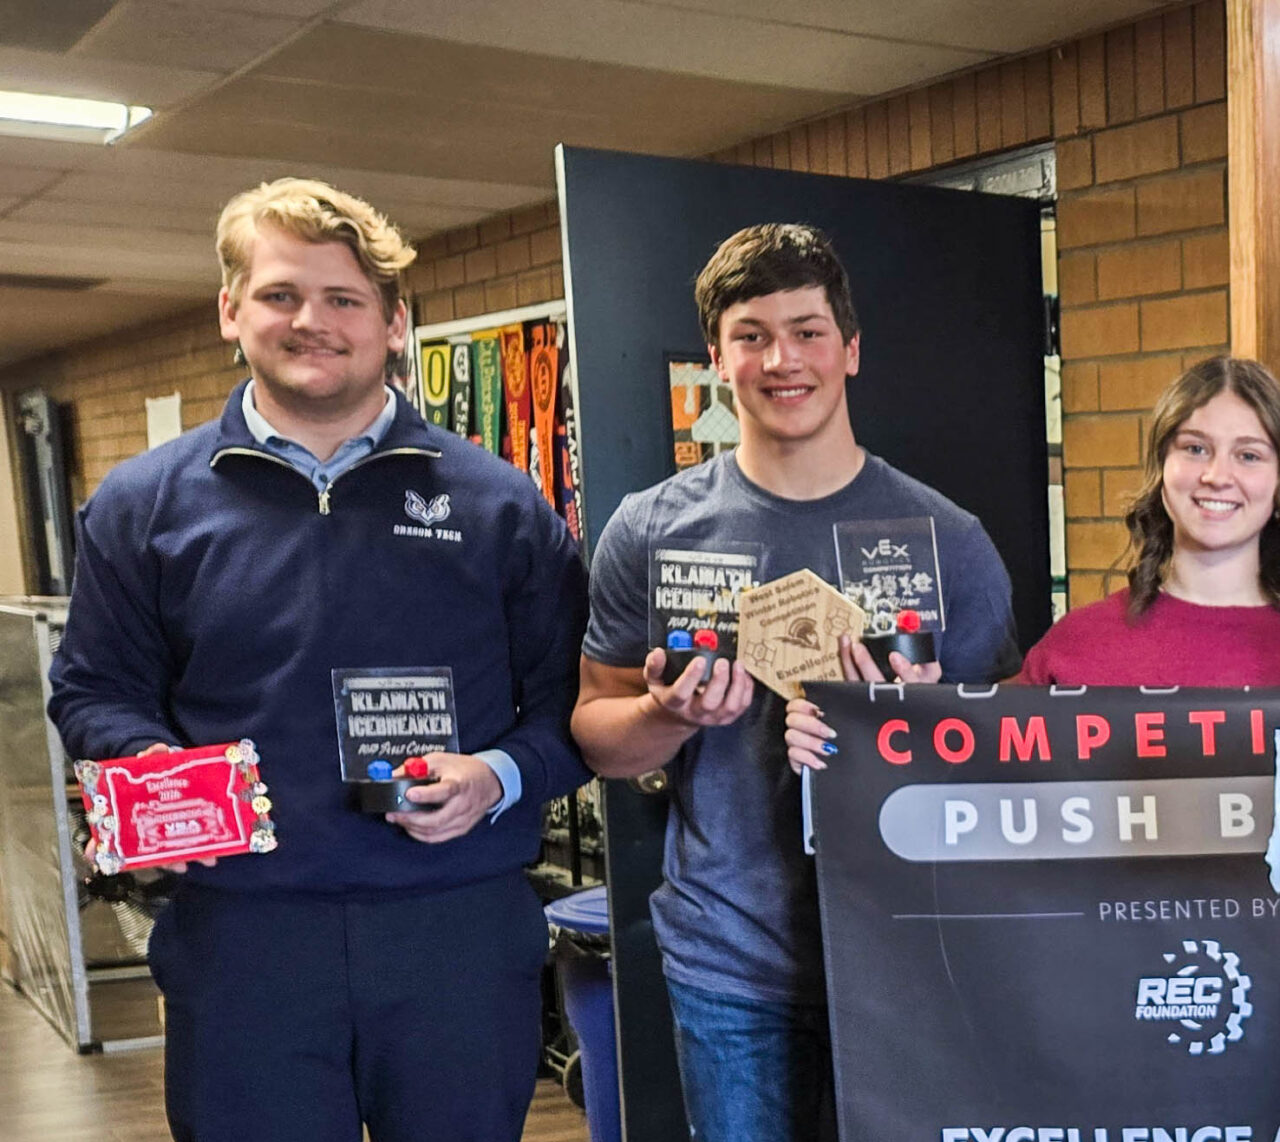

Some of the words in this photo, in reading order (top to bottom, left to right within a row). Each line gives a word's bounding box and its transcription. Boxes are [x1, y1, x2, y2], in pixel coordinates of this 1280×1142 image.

[435, 529, 463, 542] TECH
[861, 539, 911, 559] VEX
[661, 563, 753, 588] KLAMATH
[776, 652, 837, 680] Excellenc
[351, 690, 446, 712] KLAMATH
[348, 713, 453, 738] ICEBREAKER
[945, 795, 1158, 845] PUSH
[1219, 792, 1256, 838] B
[1099, 899, 1240, 922] PRESENTED
[1252, 898, 1280, 919] BY
[1137, 977, 1222, 1005] REC
[1135, 1004, 1217, 1020] FOUNDATION
